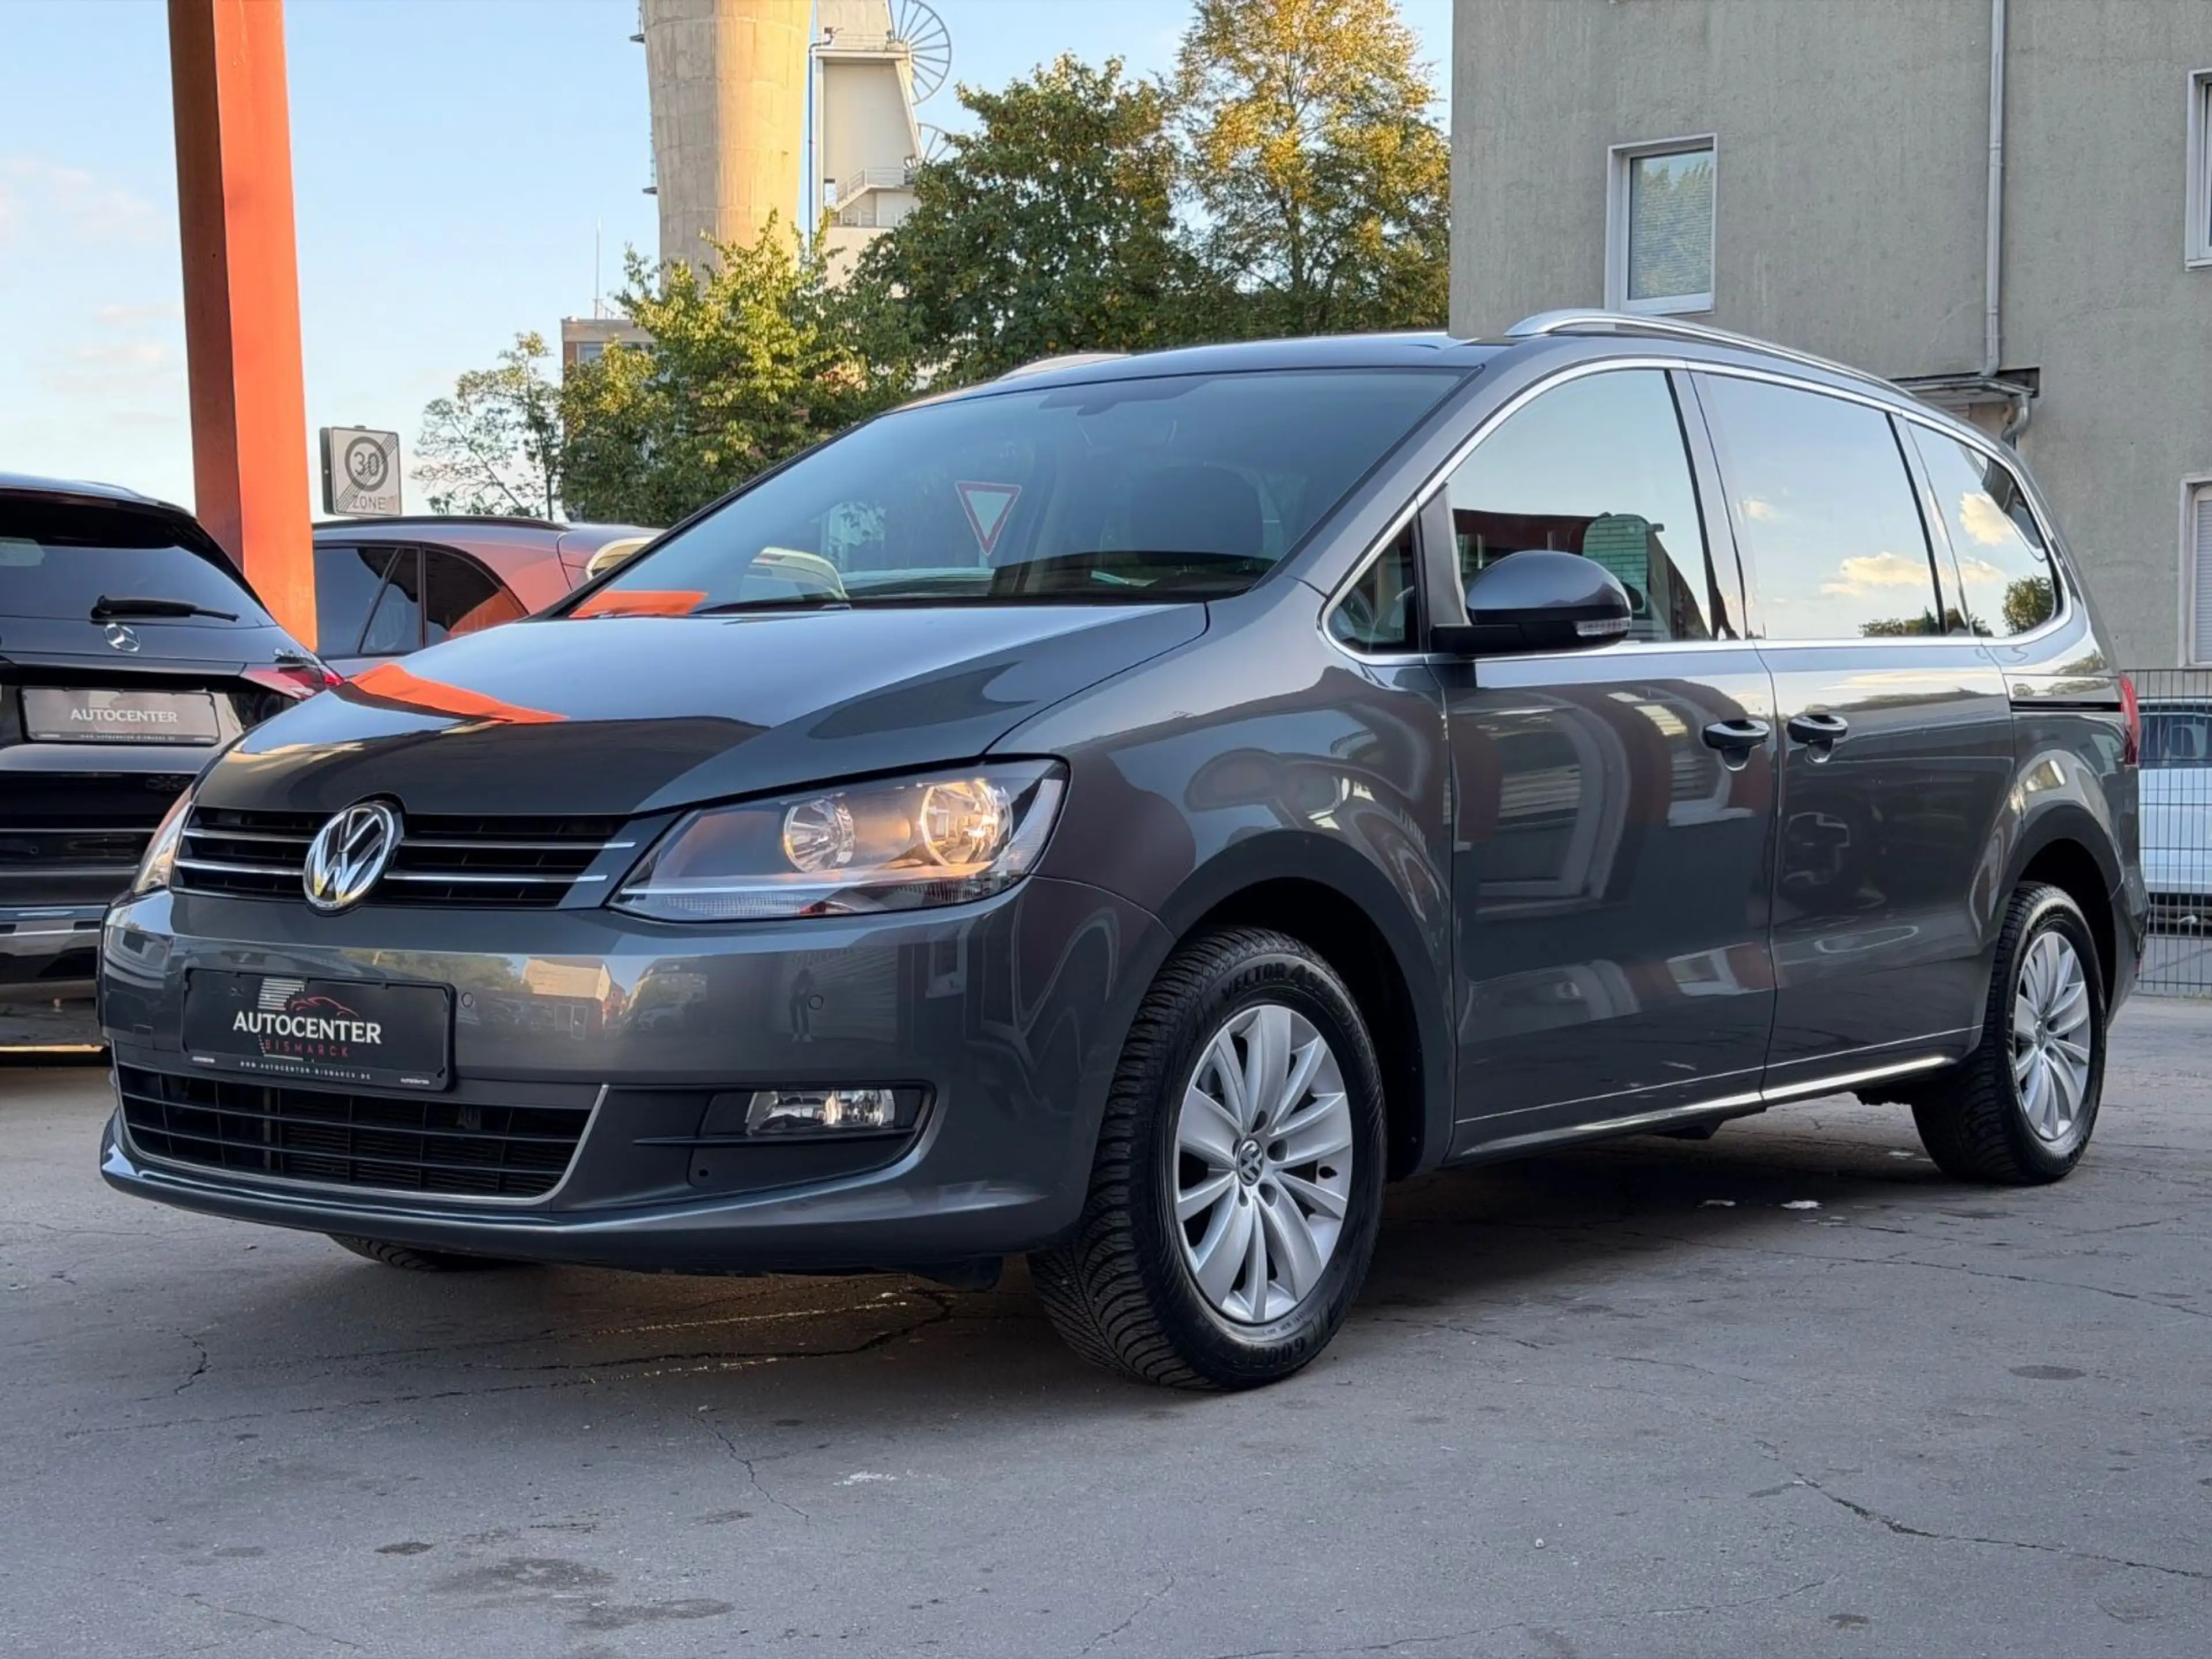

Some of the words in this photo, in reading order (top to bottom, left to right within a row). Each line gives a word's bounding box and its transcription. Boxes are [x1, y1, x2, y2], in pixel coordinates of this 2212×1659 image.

[354, 452, 380, 476] 30
[352, 494, 387, 510] ZONE
[70, 707, 178, 724] AUTOCENTER
[233, 1012, 382, 1044] AUTOCENTER
[264, 1039, 349, 1058] BISMARCK
